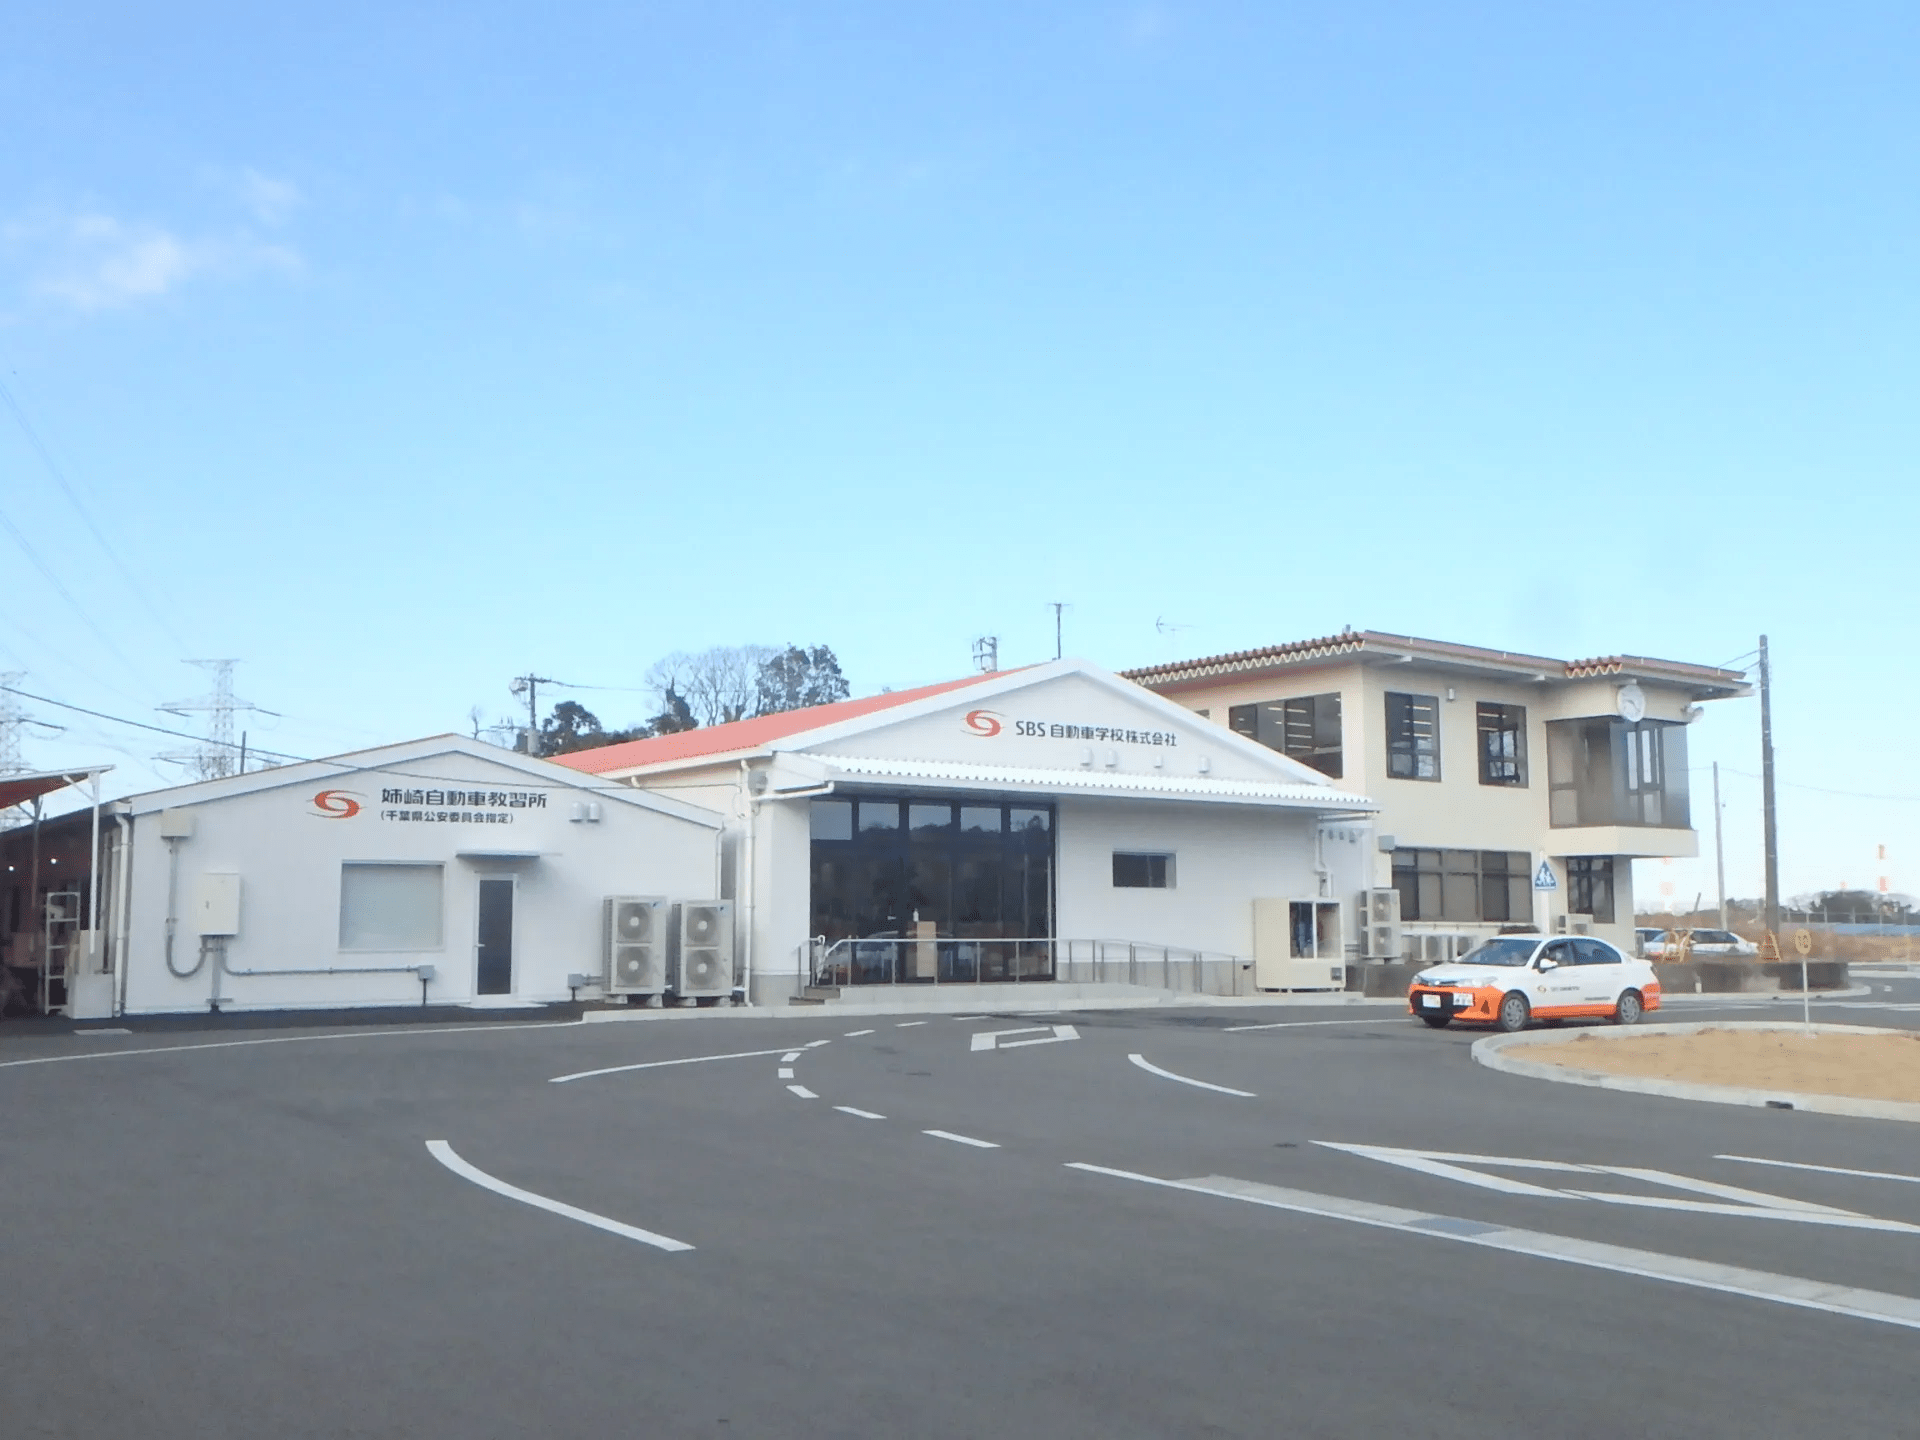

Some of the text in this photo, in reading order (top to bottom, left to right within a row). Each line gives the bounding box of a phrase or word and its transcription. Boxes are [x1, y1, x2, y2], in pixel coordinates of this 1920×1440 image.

[381, 788, 547, 808] 姉崎自動車教習所
